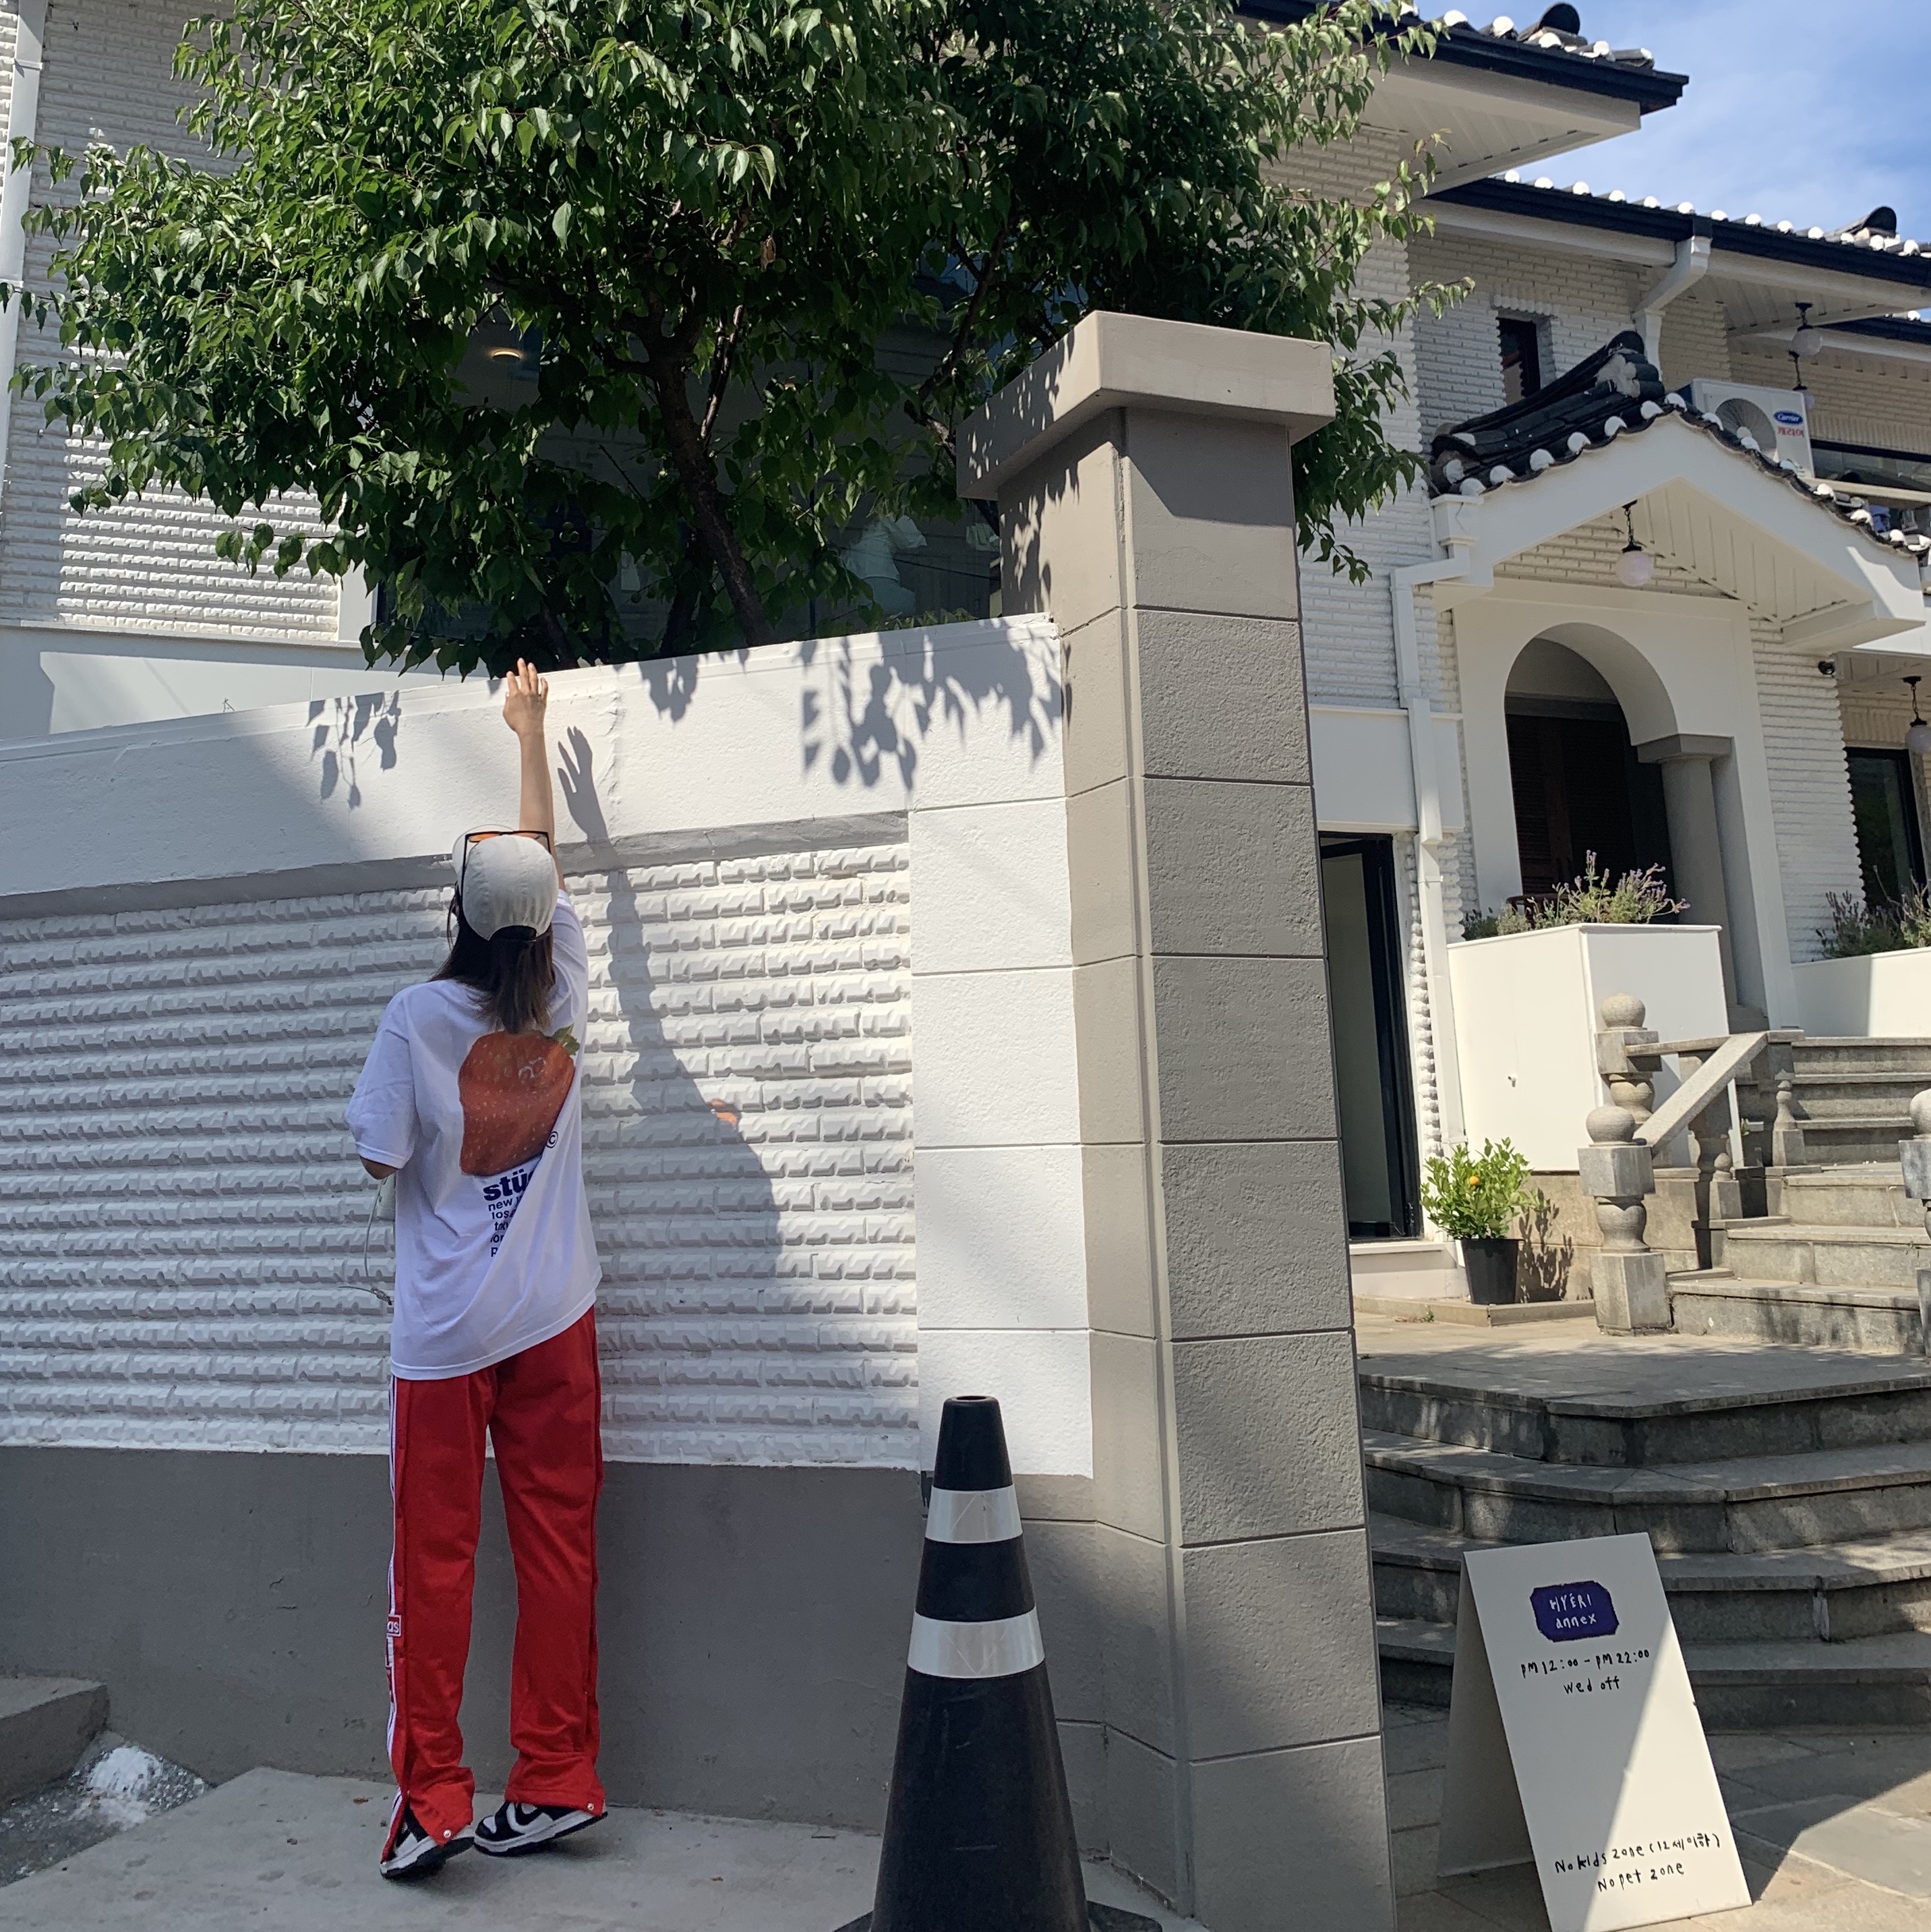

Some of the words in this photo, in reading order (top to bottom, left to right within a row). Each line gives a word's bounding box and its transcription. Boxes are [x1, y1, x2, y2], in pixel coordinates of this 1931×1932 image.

[1778, 426, 1804, 438] 캐리어
[488, 1198, 512, 1211] new
[492, 1210, 510, 1219] los
[1556, 1614, 1597, 1629] annex
[1600, 1675, 1620, 1691] off
